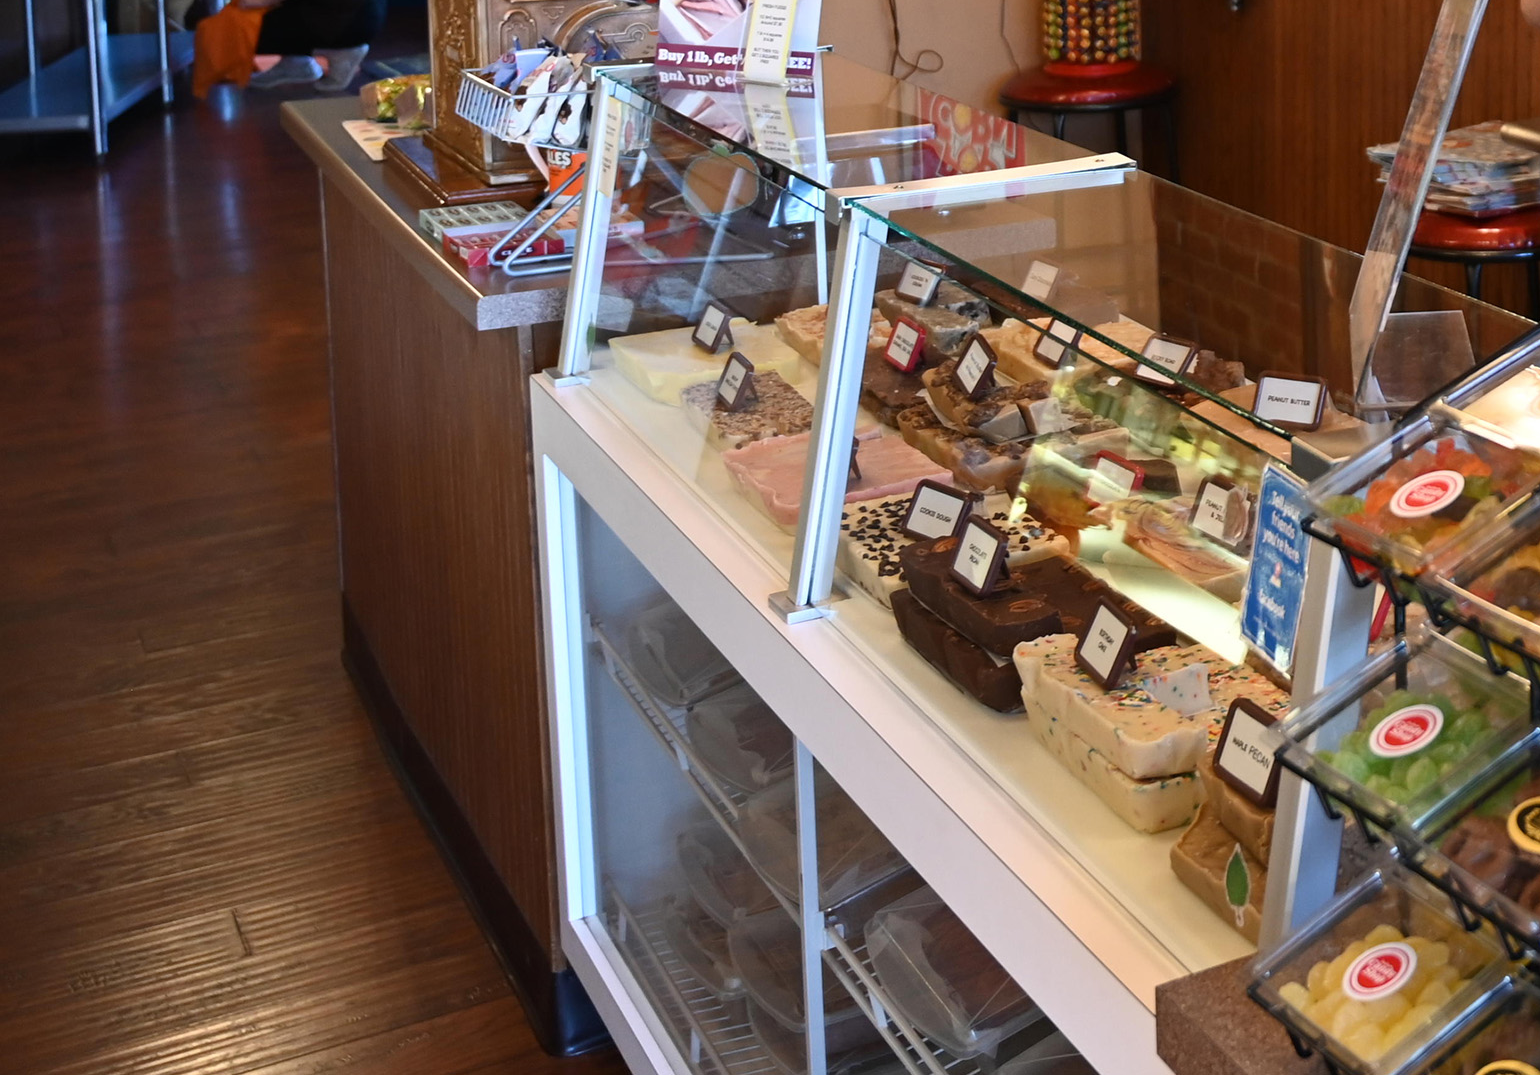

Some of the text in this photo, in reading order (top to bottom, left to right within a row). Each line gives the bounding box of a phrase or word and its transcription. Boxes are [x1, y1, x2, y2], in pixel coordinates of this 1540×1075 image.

[658, 49, 684, 64] Buy
[714, 52, 738, 65] Get
[1268, 395, 1311, 406] PEANUT BUTTER
[919, 506, 936, 517] COOKIE
[1272, 510, 1295, 540] friends
[1284, 544, 1300, 564] here
[1248, 745, 1270, 769] PECAN
